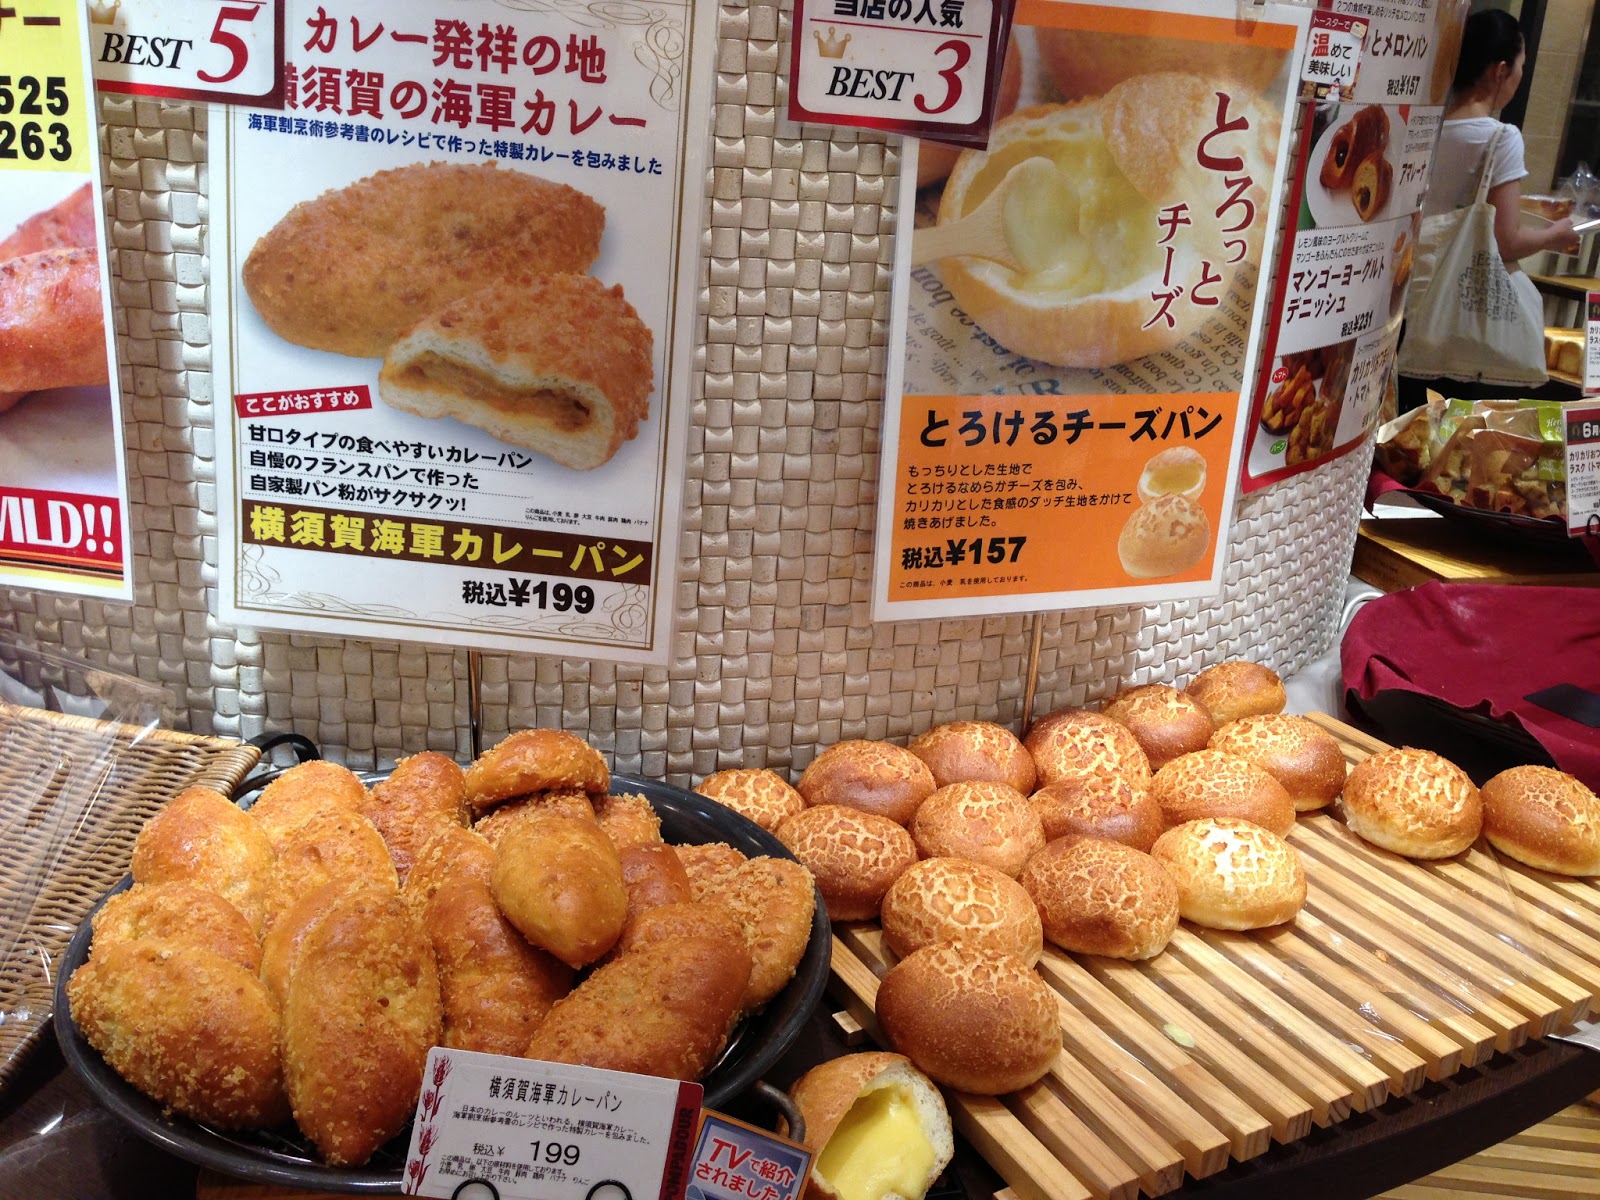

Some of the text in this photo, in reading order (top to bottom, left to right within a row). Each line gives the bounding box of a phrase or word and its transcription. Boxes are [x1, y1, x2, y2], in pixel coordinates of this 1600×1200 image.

[1313, 16, 1351, 30] トースターで
[98, 4, 260, 83] BEST 5
[303, 7, 608, 85] カレー発祥の地
[1311, 33, 1353, 60] 温めて
[825, 39, 971, 114] BEST 3
[1308, 59, 1351, 78] 美味しい
[0, 76, 69, 116] 525
[0, 121, 72, 161] 263
[1190, 91, 1256, 307] とろっと
[1142, 202, 1192, 330] チーズ
[1292, 255, 1385, 293] マンゴーヨーグルト
[1286, 293, 1346, 323] デニッシュ
[246, 390, 360, 413] ここがおすすめ
[920, 405, 1223, 447] とろけるチーズパン
[248, 424, 533, 470] 甘口タイプの食べやすいカレーパン
[249, 450, 480, 490] 自慢のフランスパンで作った
[907, 479, 1084, 495] とろけるなめらかチーズを包み、
[908, 463, 1033, 478] もっちりとした生地で
[905, 493, 1132, 513] カリカリとした食感のダッチ生地をかけて
[0, 496, 114, 554] ILD!!
[250, 505, 646, 577] 横須賀海軍カレーパン
[903, 515, 998, 530] 焼きあげました。
[901, 536, 1027, 570] 税込¥157
[462, 577, 595, 614] 税込¥199
[489, 1075, 623, 1112] 横須賀海軍カレーパン
[530, 1140, 580, 1166] 199
[709, 1138, 795, 1186] TVで紹介
